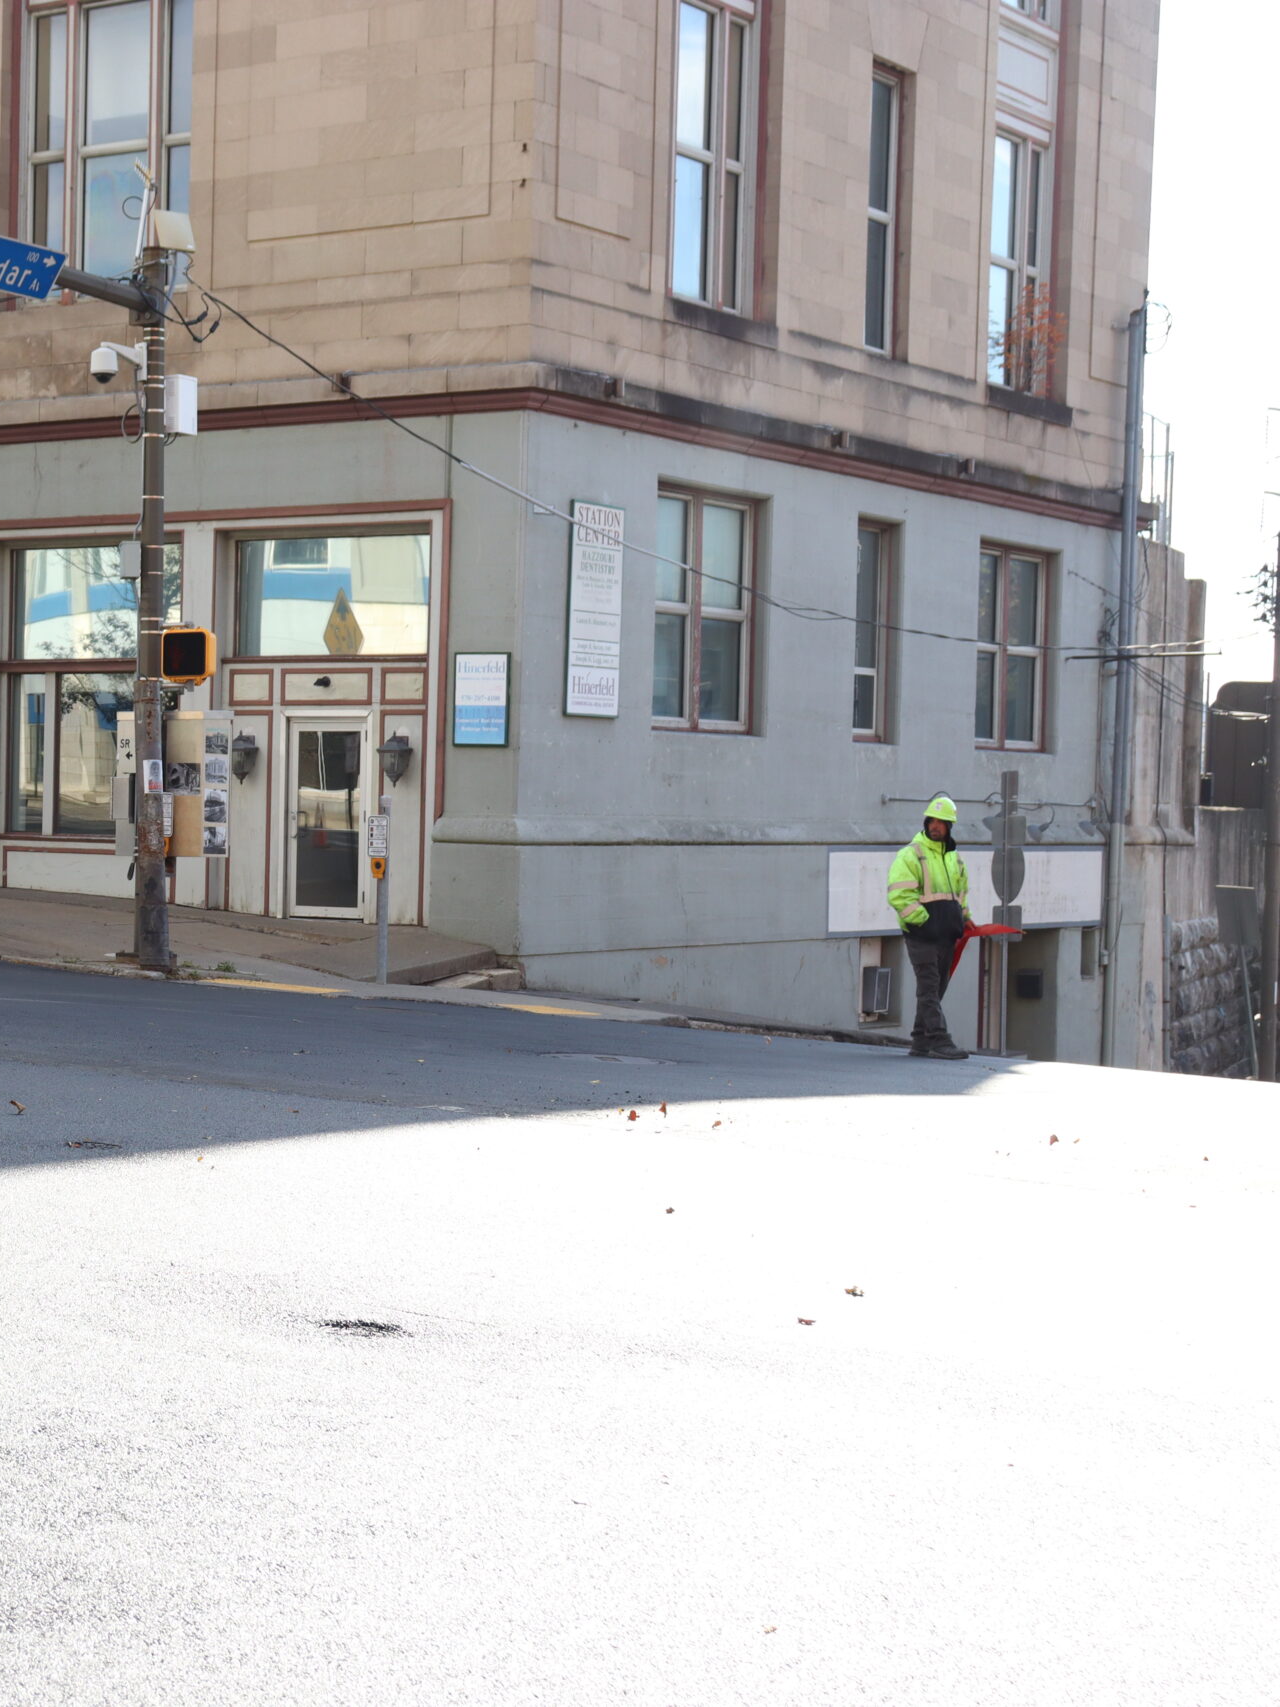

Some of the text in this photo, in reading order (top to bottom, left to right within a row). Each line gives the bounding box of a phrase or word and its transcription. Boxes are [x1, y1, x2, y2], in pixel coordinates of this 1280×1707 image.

[27, 251, 40, 262] 100
[578, 505, 621, 528] STATION
[577, 525, 621, 548] CENTER
[581, 550, 616, 565] HAZZOURI
[580, 560, 616, 577] DENTISTRY
[458, 661, 506, 673] Hinerfeld
[572, 675, 616, 697] Hinerfeld
[120, 739, 130, 749] SR
